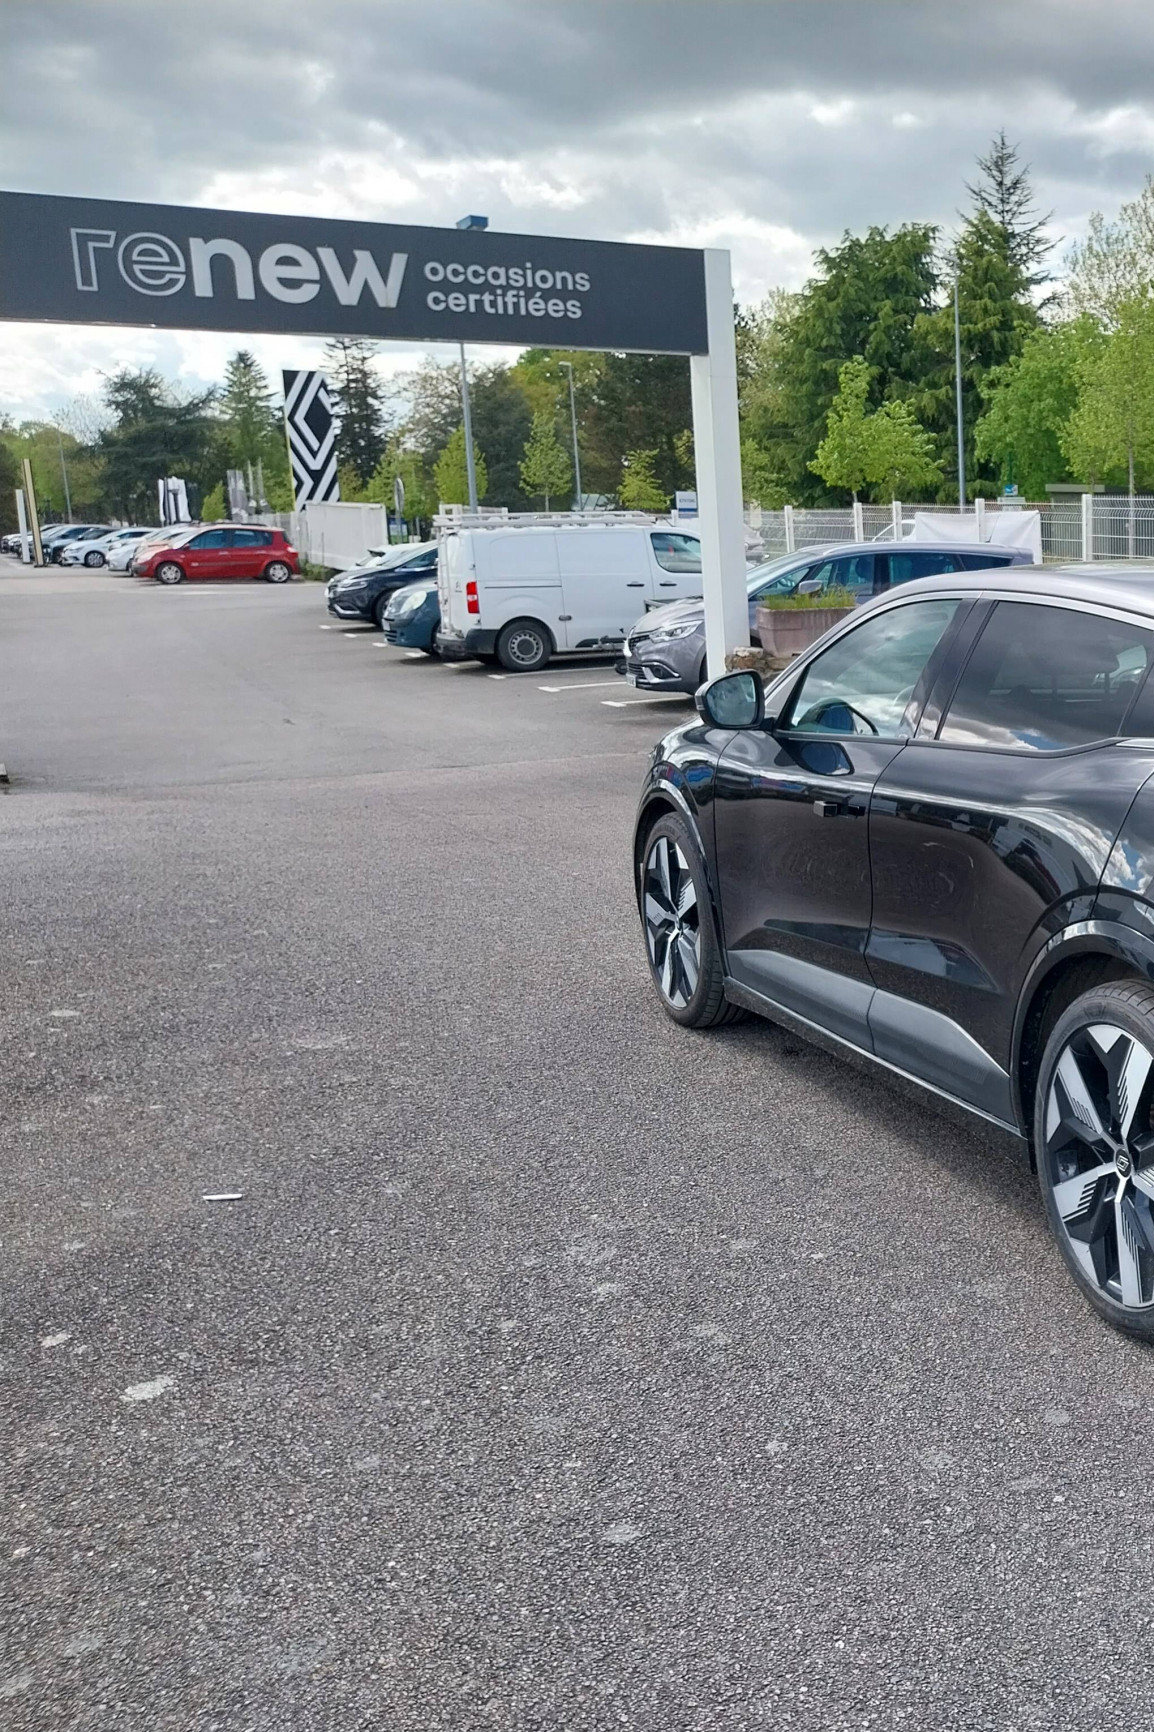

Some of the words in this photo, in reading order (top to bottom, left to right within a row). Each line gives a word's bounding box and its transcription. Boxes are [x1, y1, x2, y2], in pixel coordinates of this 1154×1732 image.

[70, 227, 409, 309] renew
[424, 261, 591, 292] occasions
[426, 288, 583, 319] certifiées
